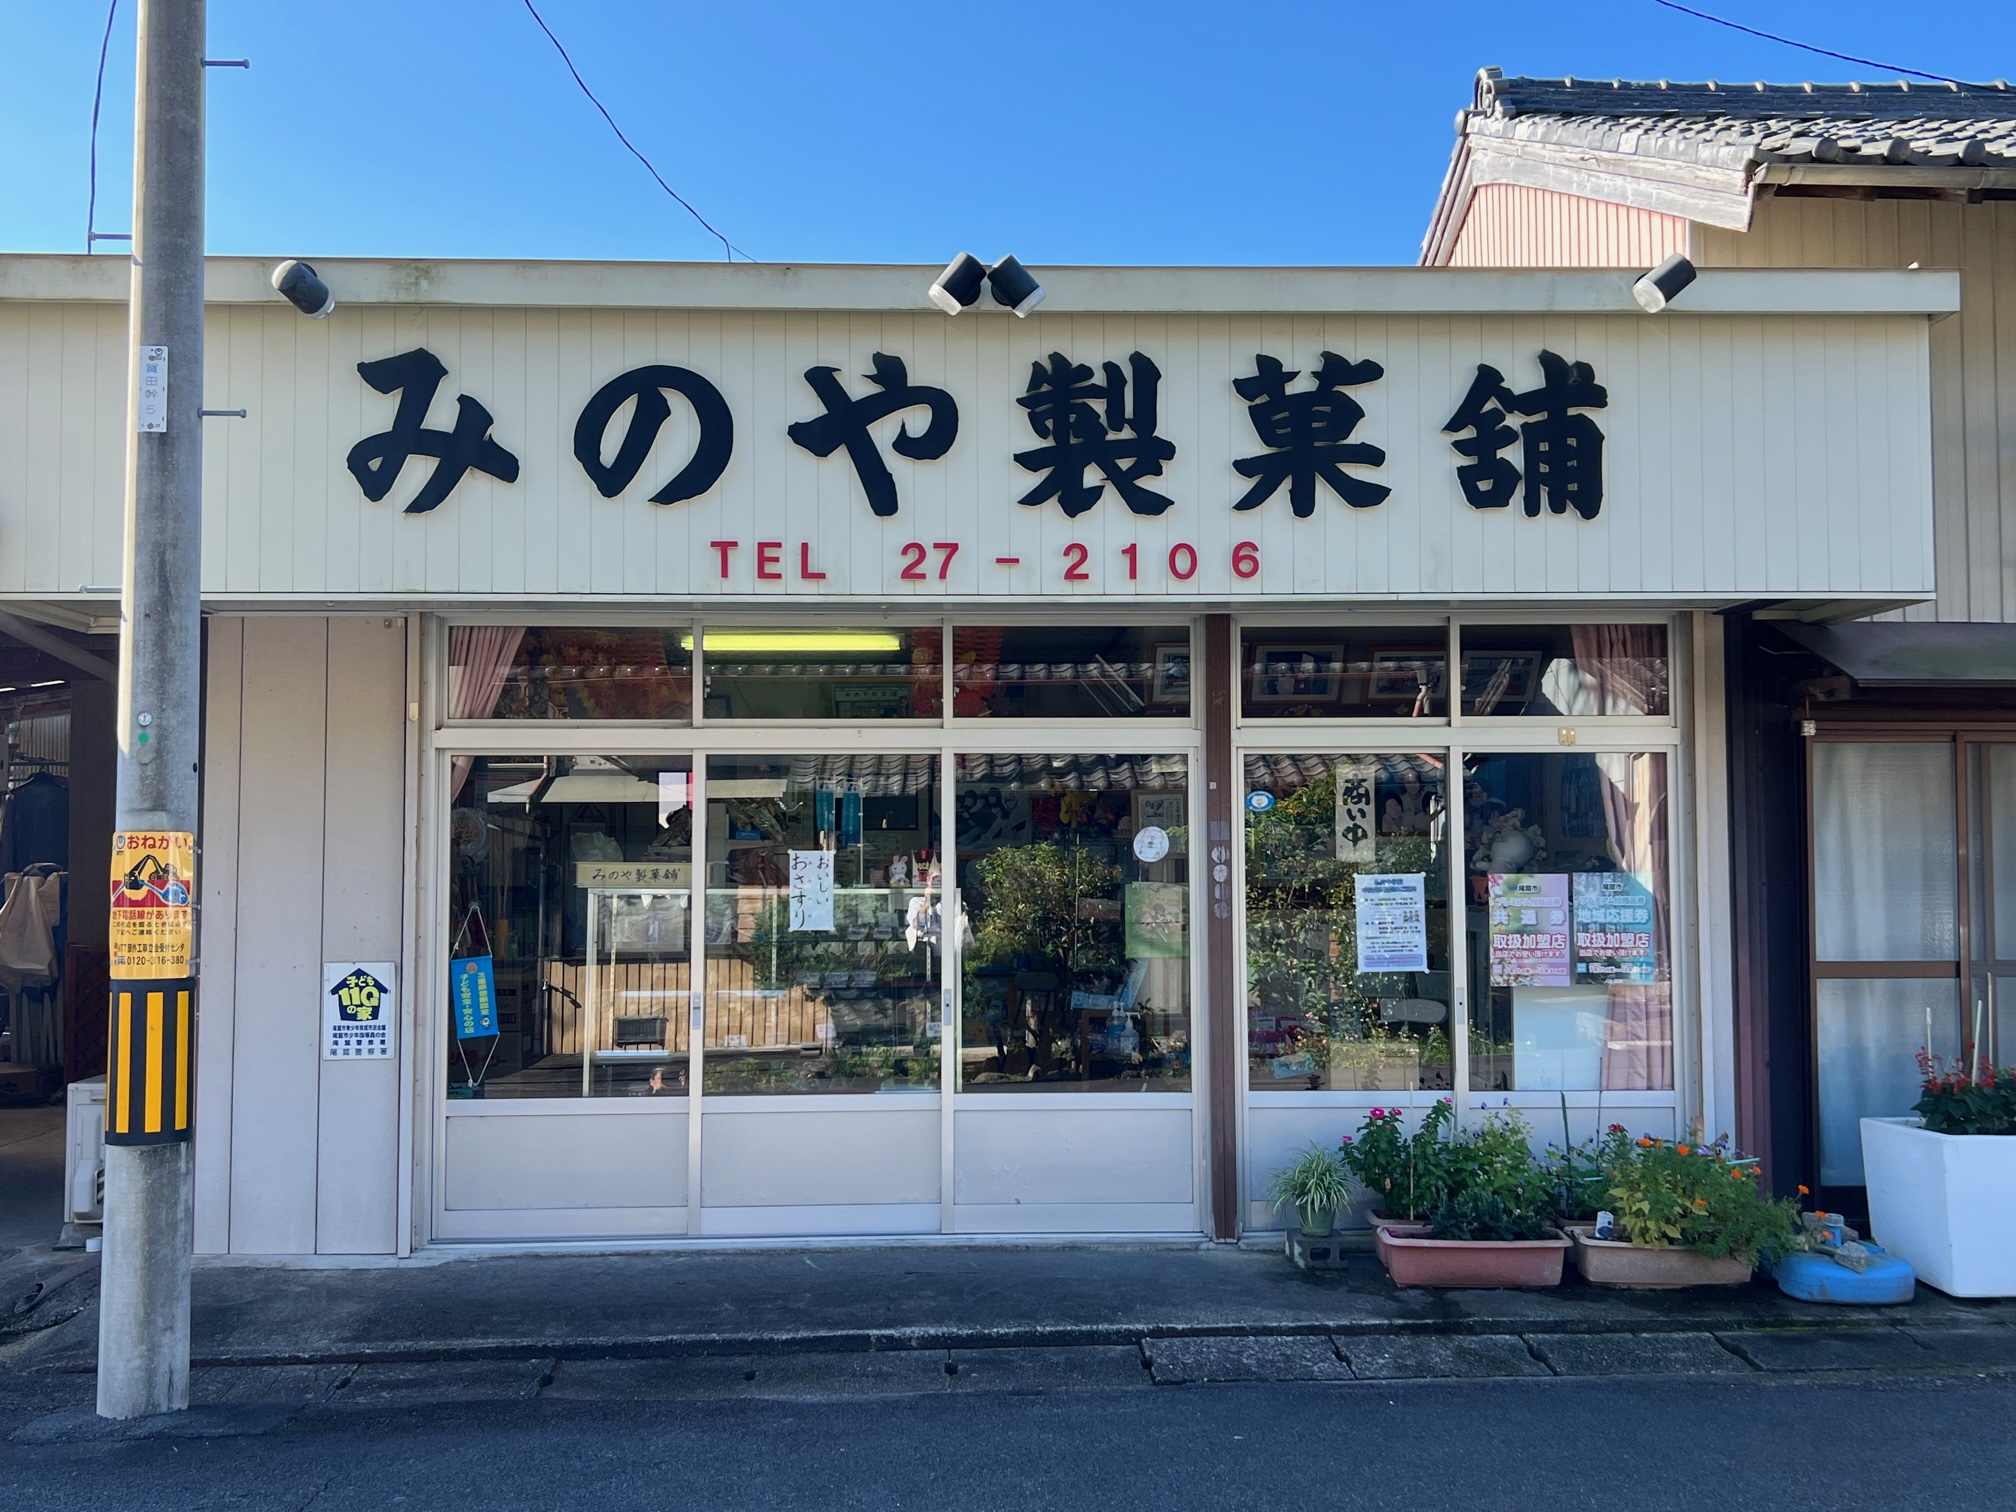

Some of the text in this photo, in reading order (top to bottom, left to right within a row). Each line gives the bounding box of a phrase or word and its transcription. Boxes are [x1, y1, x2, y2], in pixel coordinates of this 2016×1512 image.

[347, 347, 1608, 520] みのや製菓舗
[710, 541, 826, 580] TEL
[127, 835, 188, 850] おねがい
[592, 868, 680, 882] みのや製菓舗
[816, 855, 830, 905] おいしい
[790, 852, 808, 929] おさすり
[112, 910, 189, 921] 地下電話線があります
[1493, 909, 1566, 925] 共通券
[1577, 908, 1650, 925] 地域応援券
[1493, 933, 1567, 948] 取扱加盟店
[1577, 932, 1650, 948] 取扱加盟店
[127, 956, 185, 966] 0120-316-380
[346, 975, 375, 987] 子ども
[338, 986, 380, 1007] 110
[346, 1005, 373, 1020] の家
